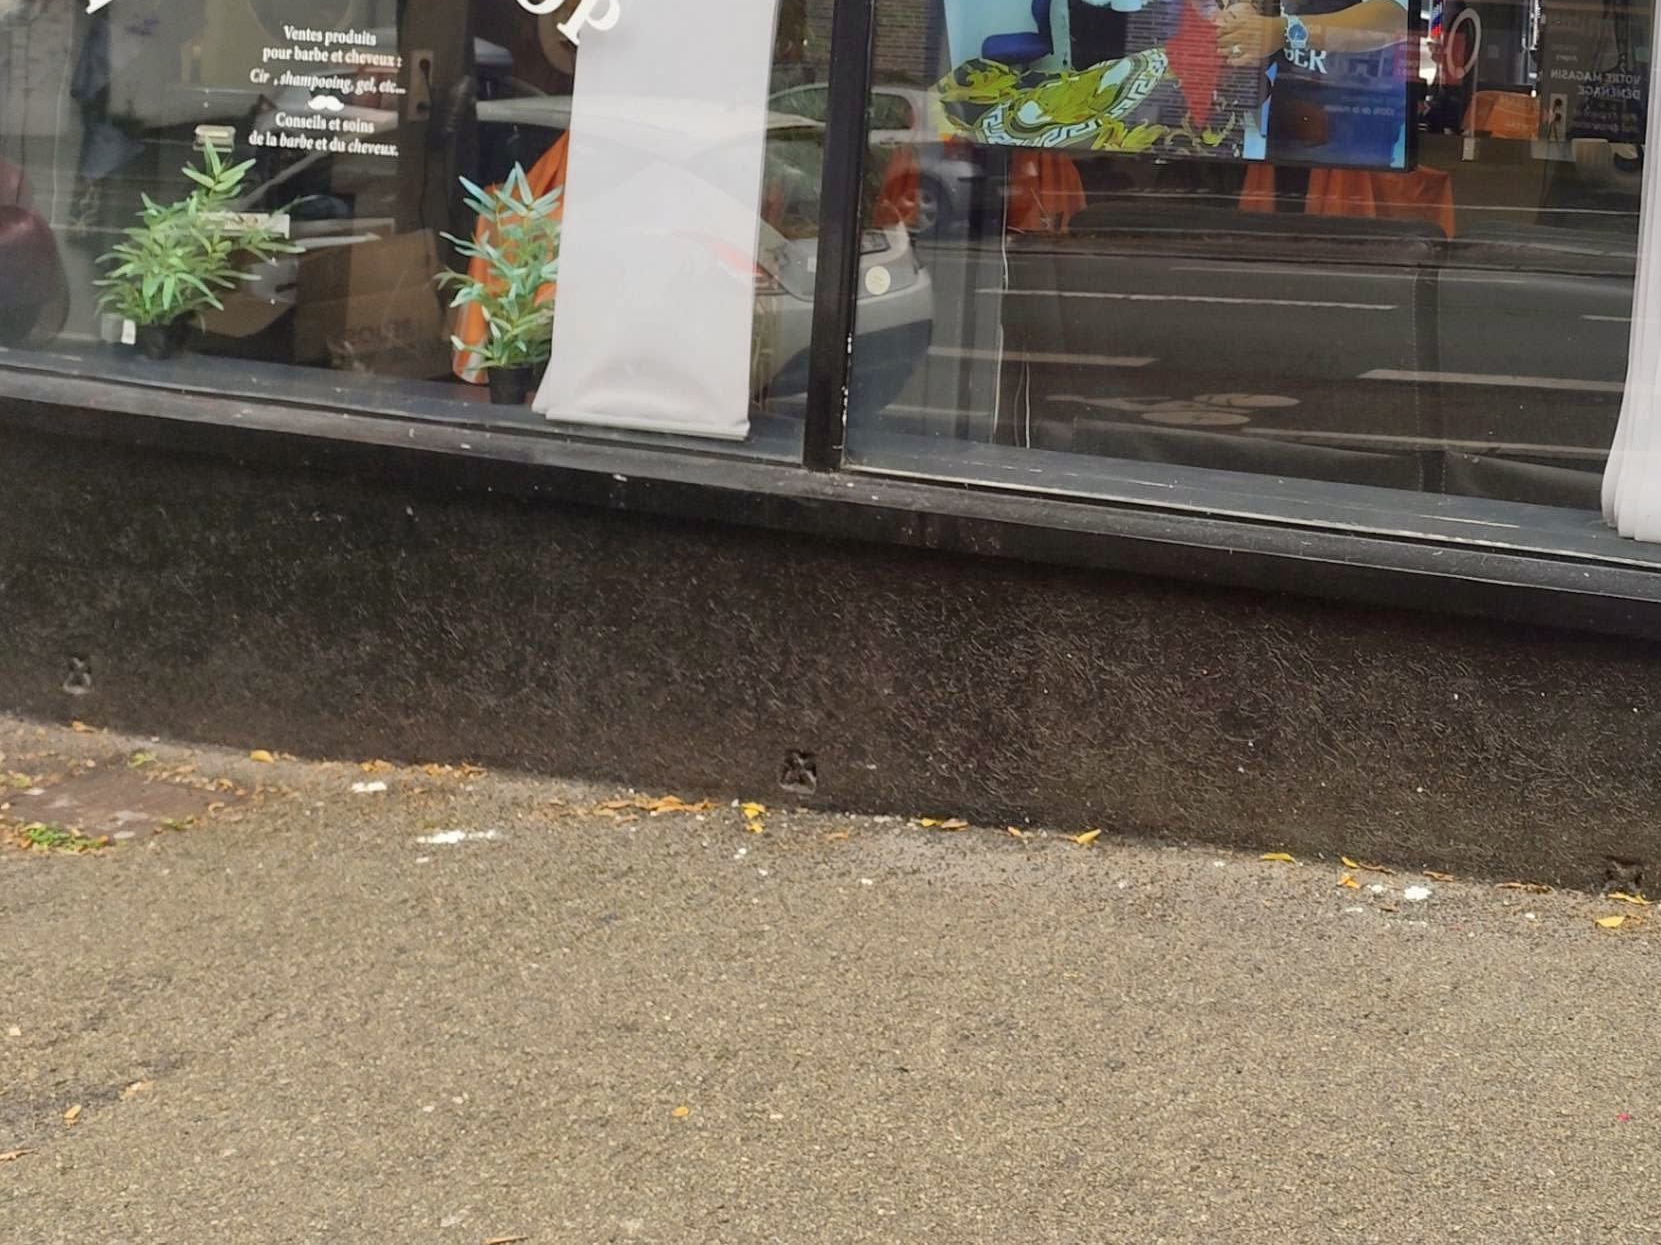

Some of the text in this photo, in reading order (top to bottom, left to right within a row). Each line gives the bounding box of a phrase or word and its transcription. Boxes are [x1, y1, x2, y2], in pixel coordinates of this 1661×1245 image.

[283, 24, 377, 46] Ventes produits
[262, 46, 293, 63] pour
[294, 45, 328, 62] barbe
[330, 50, 343, 64] et
[344, 48, 395, 68] cheveux
[275, 111, 375, 134] Conseils et soins
[248, 129, 264, 146] de
[265, 130, 278, 147] la
[279, 131, 315, 150] barbe
[315, 137, 327, 151] et
[329, 135, 346, 152] du
